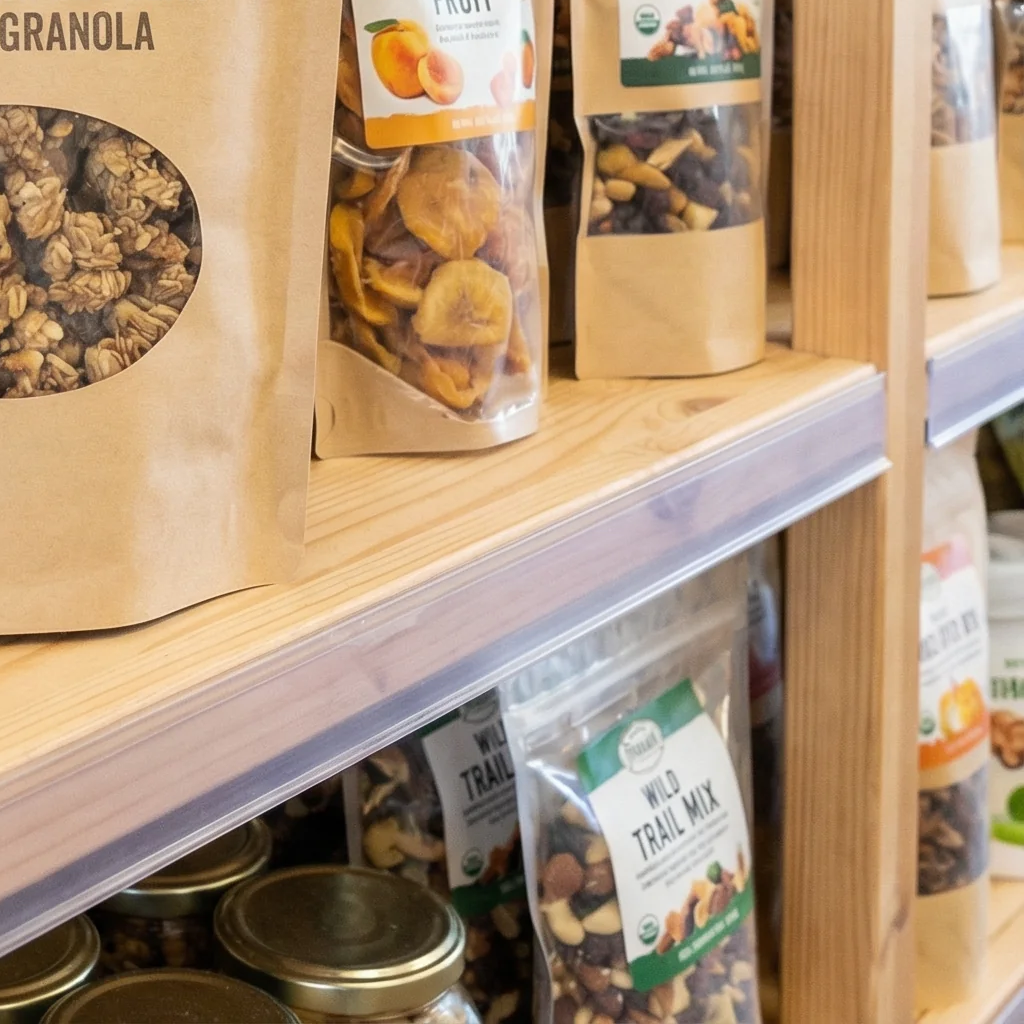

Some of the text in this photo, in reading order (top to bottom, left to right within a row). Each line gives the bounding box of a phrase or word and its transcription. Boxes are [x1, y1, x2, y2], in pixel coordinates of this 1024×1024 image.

[0, 11, 155, 52] GRANOLA
[460, 752, 515, 802] TRAIL
[640, 769, 681, 811] WILD
[632, 806, 686, 862] TRAIL
[682, 779, 721, 823] MIX
